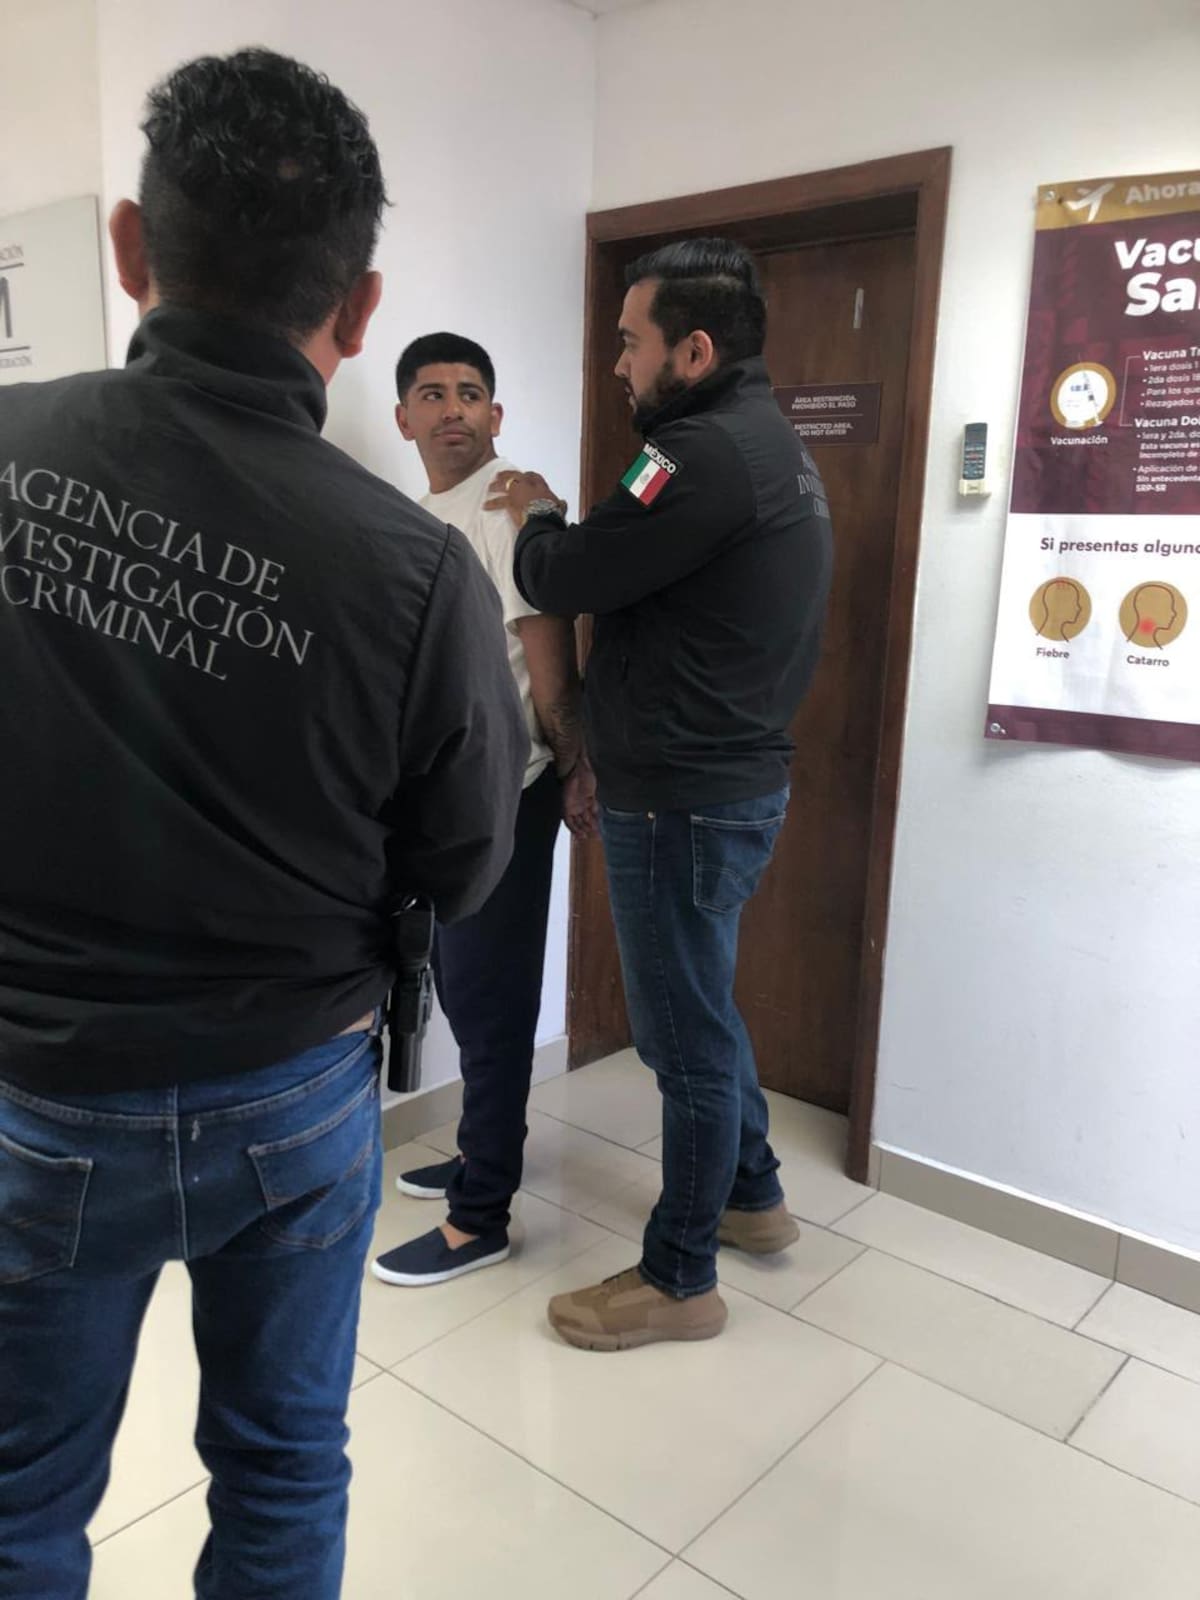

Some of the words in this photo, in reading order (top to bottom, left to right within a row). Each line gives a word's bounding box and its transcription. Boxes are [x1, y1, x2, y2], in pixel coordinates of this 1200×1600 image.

[1125, 182, 1200, 206] Ahora
[1114, 238, 1200, 270] Vac
[1124, 272, 1200, 317] Sa
[1142, 350, 1187, 361] Vacuna
[1169, 361, 1193, 371] dosis
[1147, 374, 1165, 384] 2da
[1166, 372, 1190, 383] dosis
[1146, 388, 1166, 396] Para
[1168, 386, 1182, 396] los
[1144, 398, 1194, 408] Rezagados
[1134, 417, 1178, 428] Vacuna
[1050, 435, 1109, 446] Vacunación
[1160, 441, 1189, 450] vacuna
[1138, 463, 1184, 474] Aplicación
[1185, 463, 1198, 473] de
[0, 461, 208, 574] AGENCIA
[216, 542, 286, 603] DE
[1040, 537, 1055, 551] Si
[1059, 538, 1138, 556] presentas
[1, 564, 227, 681] CRIMINAL
[1035, 646, 1070, 660] Fiebre
[1126, 654, 1170, 668] Catarro
